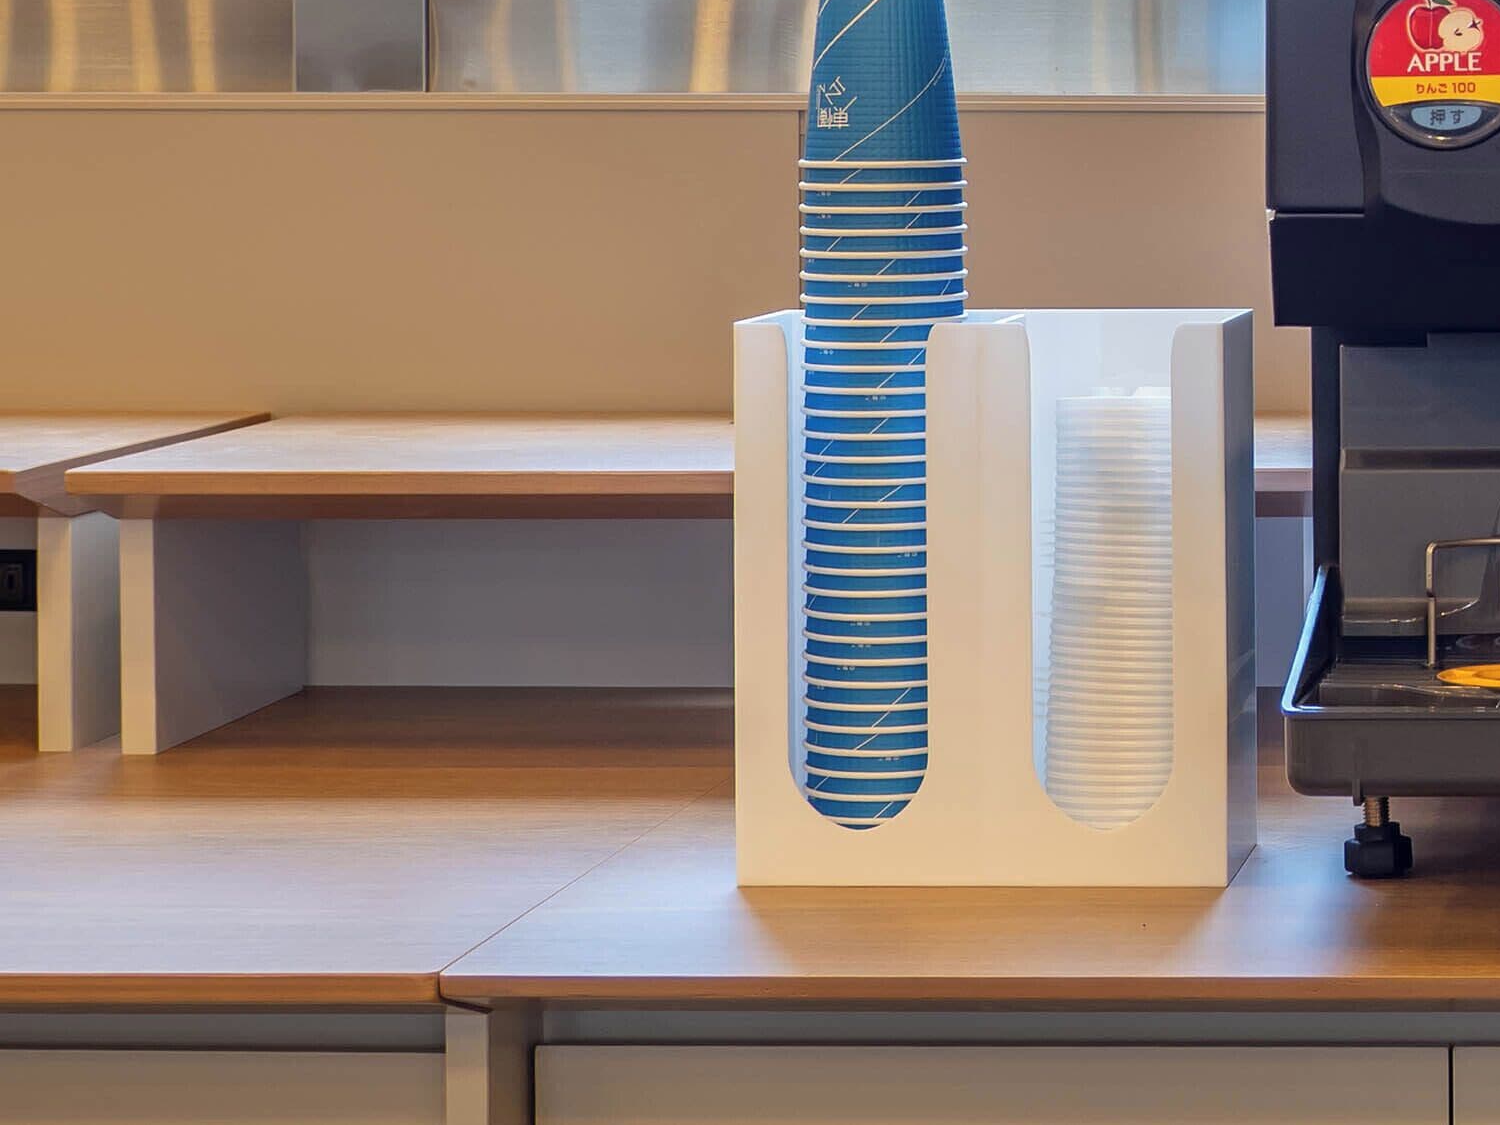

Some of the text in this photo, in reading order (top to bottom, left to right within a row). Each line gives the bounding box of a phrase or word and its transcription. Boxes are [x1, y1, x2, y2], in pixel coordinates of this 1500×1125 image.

[1407, 52, 1482, 73] APPLE
[1452, 82, 1476, 94] 100
[1430, 109, 1464, 125] 押す
